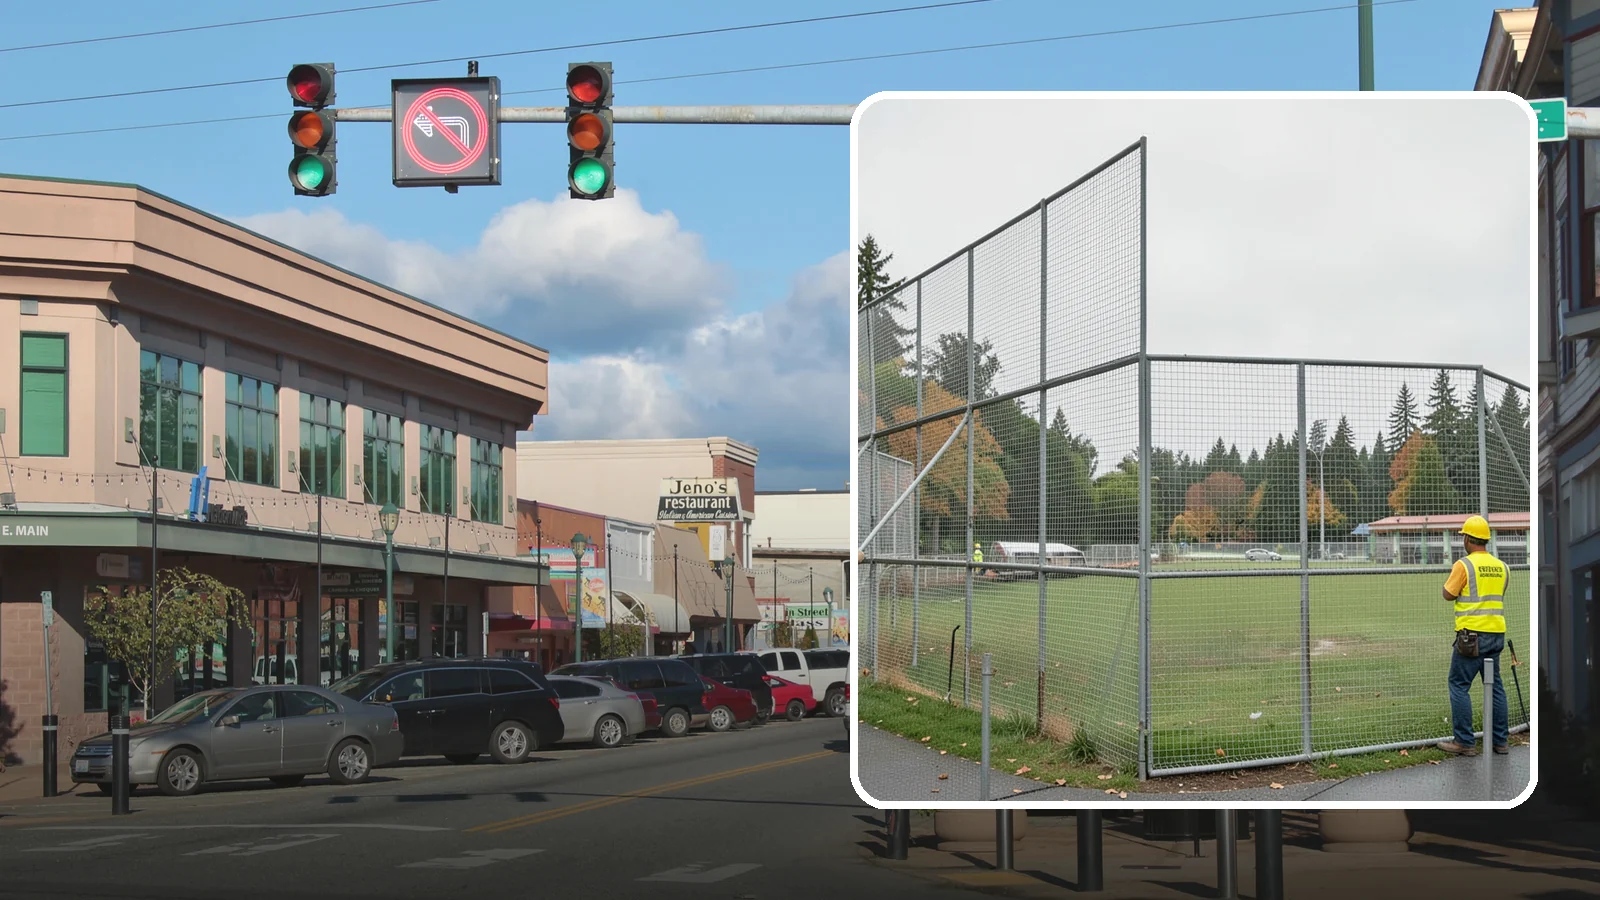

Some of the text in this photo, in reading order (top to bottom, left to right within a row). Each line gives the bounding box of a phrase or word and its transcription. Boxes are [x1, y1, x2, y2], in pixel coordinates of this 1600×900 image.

[669, 480, 727, 494] Jeno's
[665, 497, 731, 509] restaurant
[658, 510, 681, 519] Italian
[686, 510, 714, 519] American
[715, 509, 737, 519] Cuisine
[2, 525, 49, 536] E. MAIN
[797, 607, 828, 617] Street
